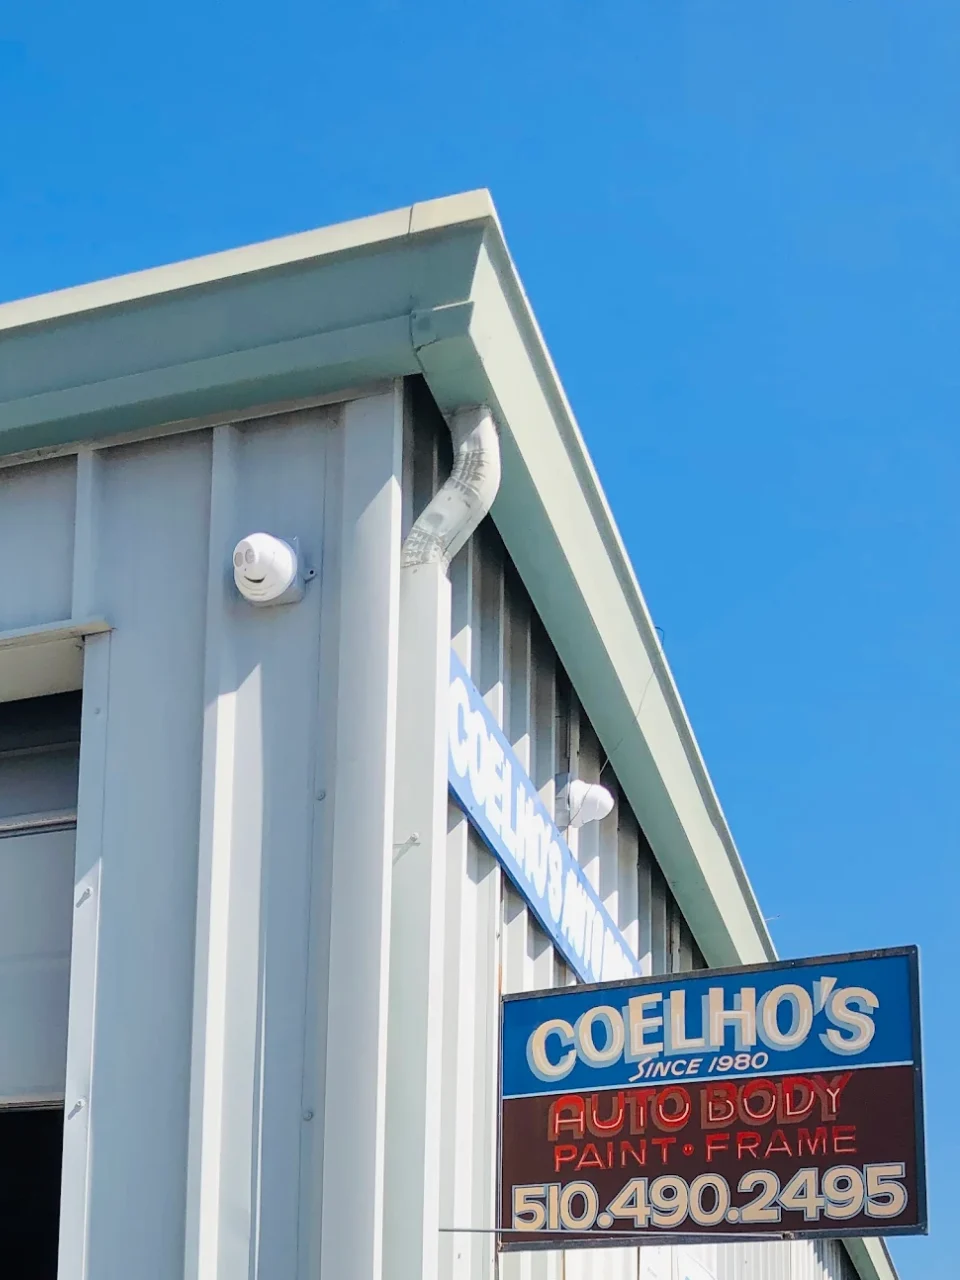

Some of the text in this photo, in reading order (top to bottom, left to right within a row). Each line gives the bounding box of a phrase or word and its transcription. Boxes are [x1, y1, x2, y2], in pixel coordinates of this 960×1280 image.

[529, 975, 880, 1080] COELHO'S
[629, 1052, 769, 1082] SINCE 1980
[551, 1072, 853, 1138] AUTO BODY
[553, 1125, 858, 1173] PAINT FRAME
[511, 1161, 908, 1232] 510.490.2495
